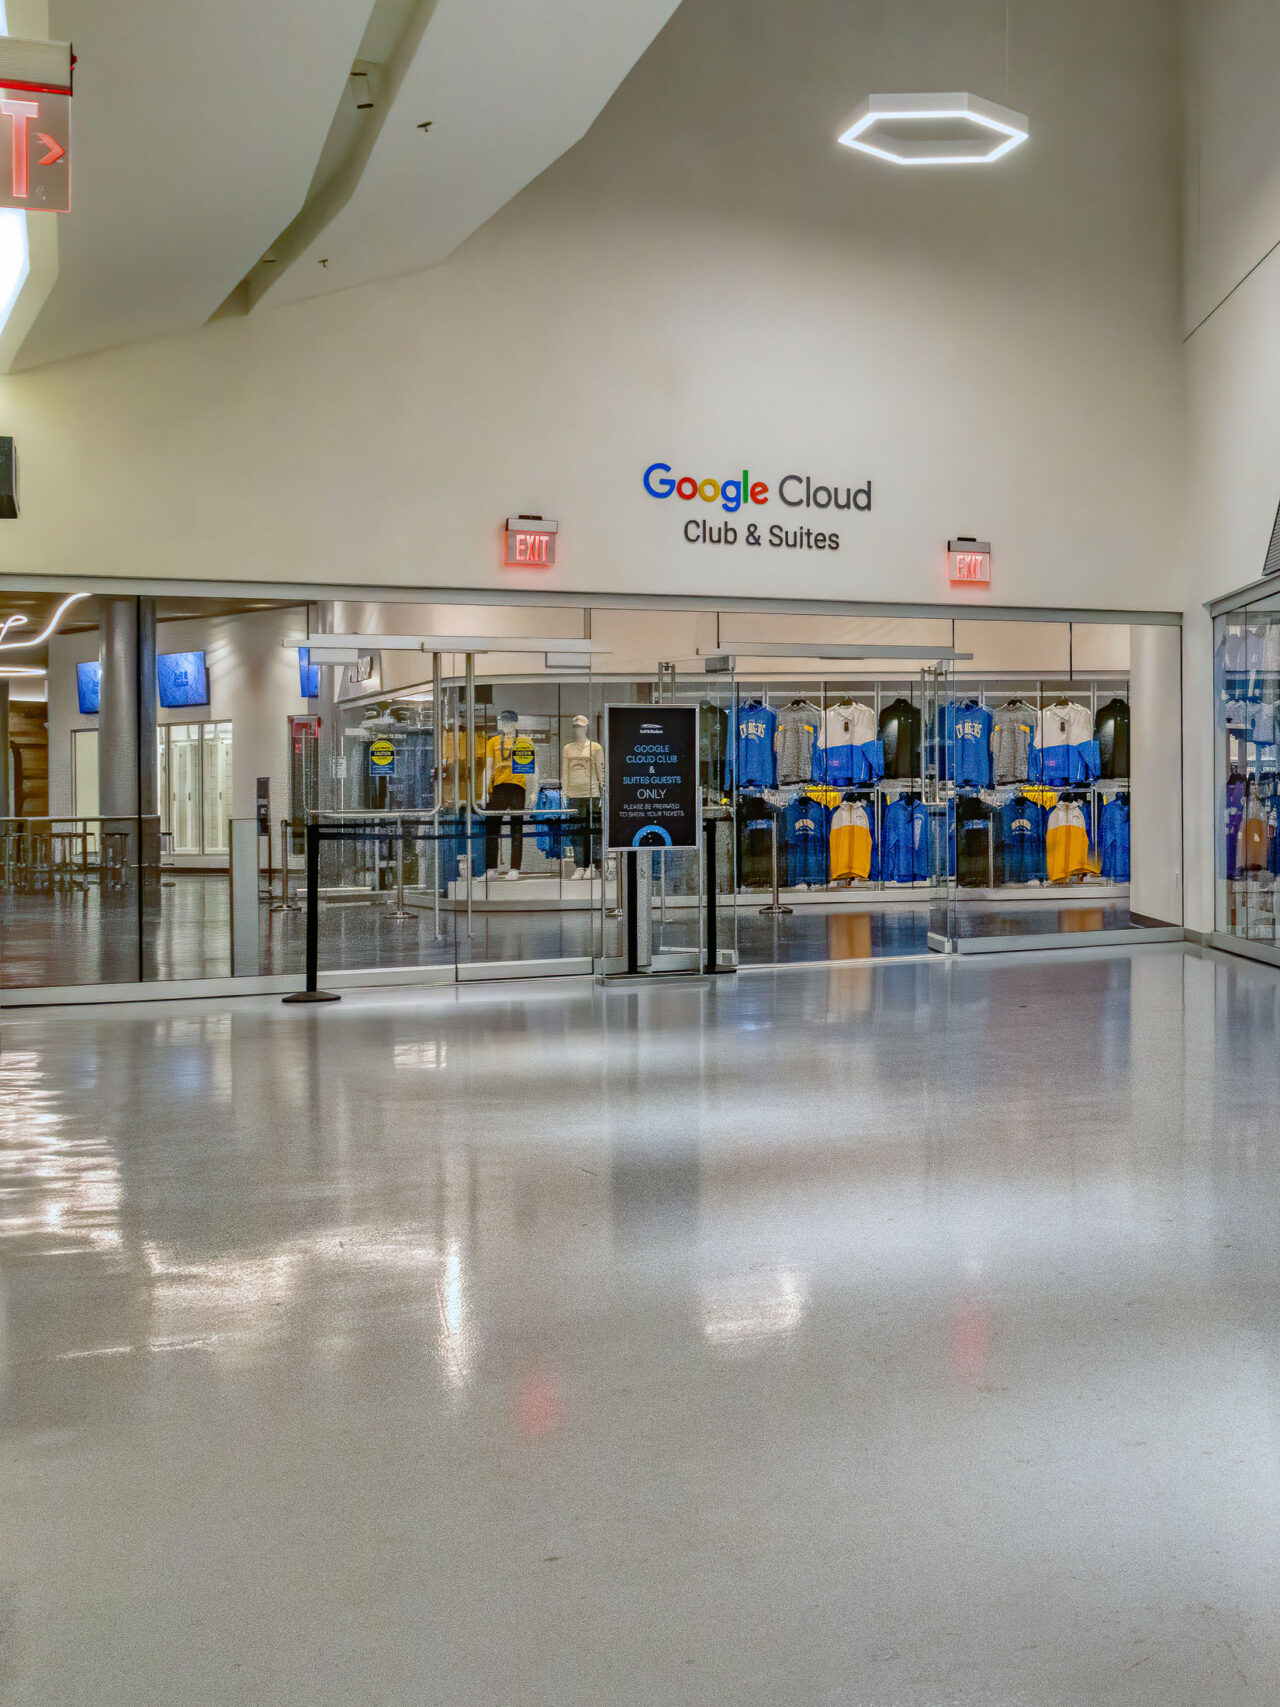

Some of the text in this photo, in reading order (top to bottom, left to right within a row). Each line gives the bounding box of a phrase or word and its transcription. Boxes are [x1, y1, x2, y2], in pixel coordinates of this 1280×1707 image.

[643, 463, 872, 513] Google Cloud
[683, 519, 840, 550] Club & Suites
[516, 534, 550, 562] EXIT
[957, 555, 983, 579] EXIT
[634, 744, 670, 753] GOOGLE
[626, 755, 678, 764] CLOUD CLUB
[623, 776, 681, 784] SUITES GUESTS
[636, 788, 667, 799] ONLY
